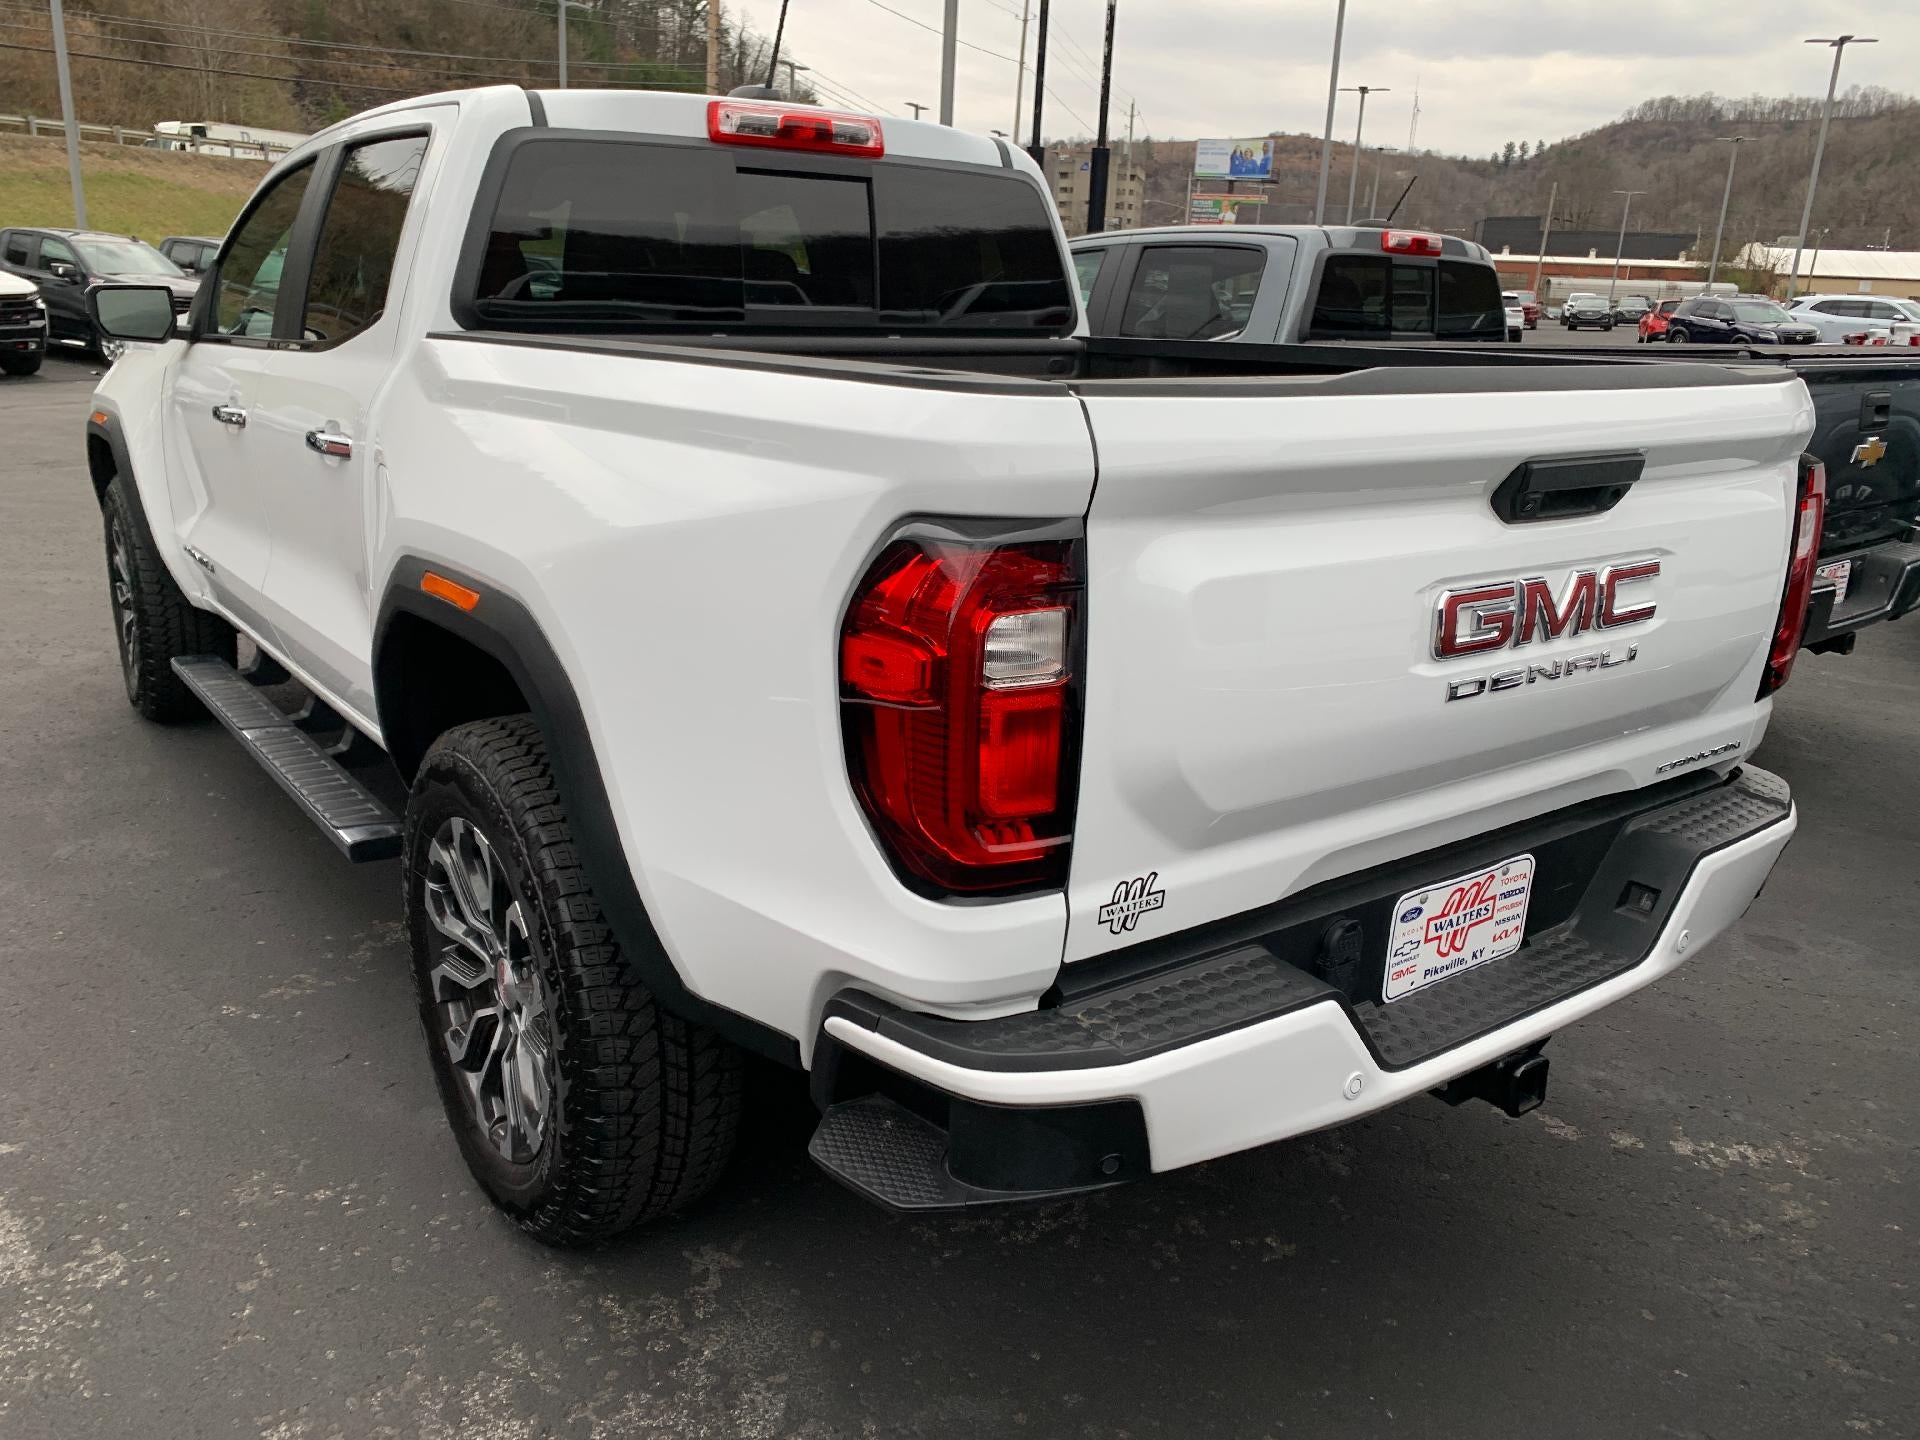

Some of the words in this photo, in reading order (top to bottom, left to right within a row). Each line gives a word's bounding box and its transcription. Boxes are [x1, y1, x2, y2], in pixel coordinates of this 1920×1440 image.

[1430, 559, 1660, 661] GMC
[1445, 643, 1638, 702] DENALI
[1501, 872, 1527, 886] TOYOTA
[1106, 897, 1159, 917] WALTERS
[1433, 904, 1490, 932] WALTERS
[1494, 912, 1521, 927] NISSAN
[1391, 965, 1417, 981] GMC
[1423, 957, 1467, 980] Pikeville,
[1471, 947, 1485, 961] KY
